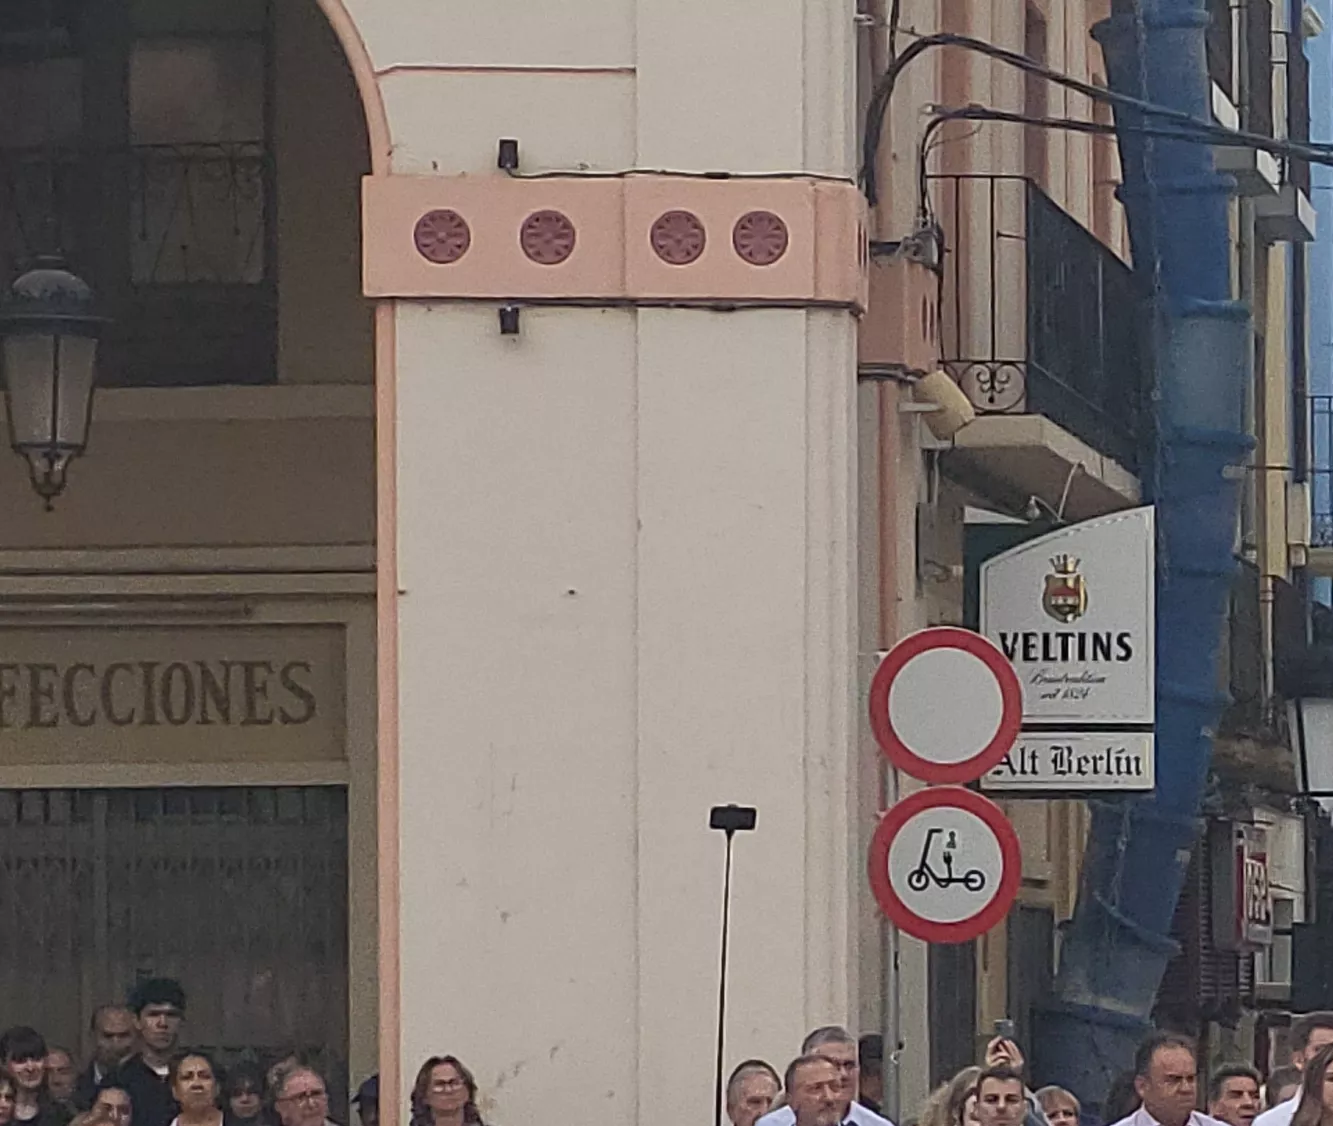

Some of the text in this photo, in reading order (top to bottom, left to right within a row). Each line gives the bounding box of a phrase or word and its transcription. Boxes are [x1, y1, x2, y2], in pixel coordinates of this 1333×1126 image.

[999, 632, 1133, 662] VELTINS
[0, 660, 317, 728] FECCIONES
[991, 745, 1142, 776] Alt Berlin
